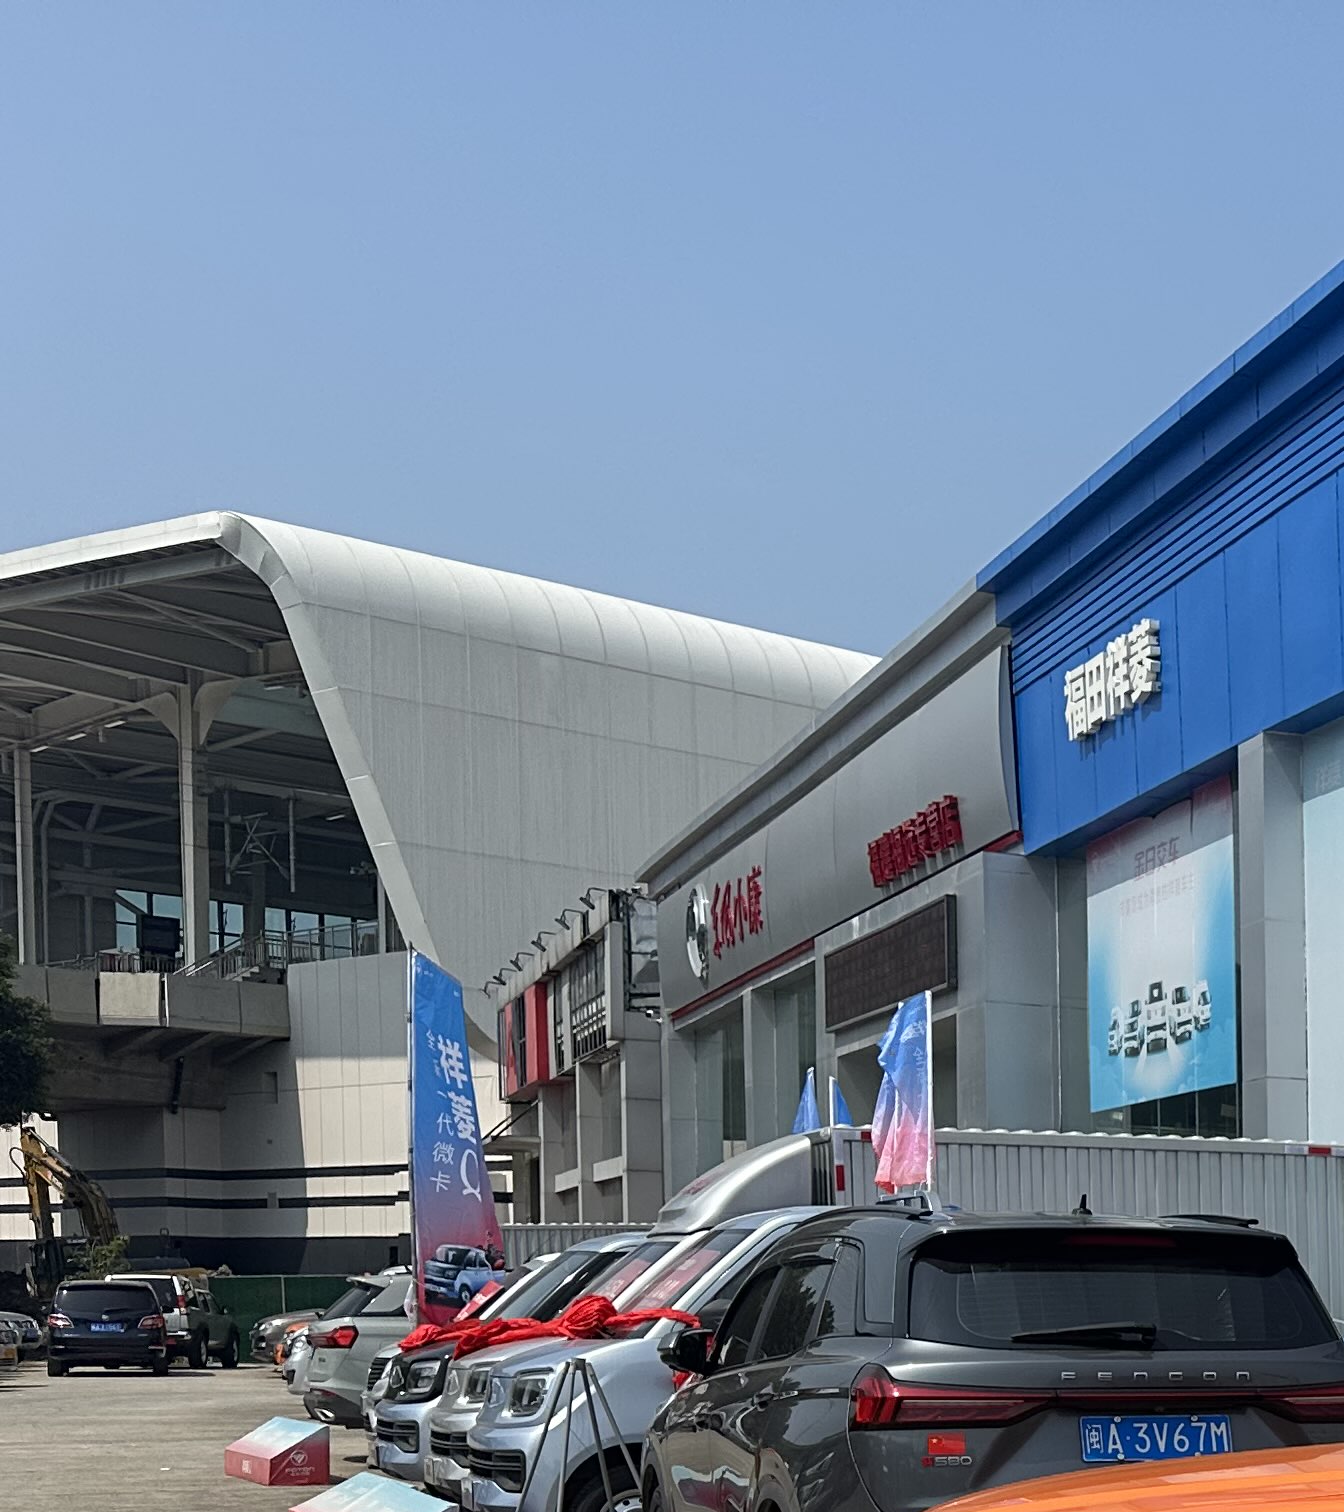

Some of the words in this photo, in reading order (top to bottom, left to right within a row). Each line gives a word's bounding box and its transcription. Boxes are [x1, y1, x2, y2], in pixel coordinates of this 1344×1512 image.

[1064, 618, 1160, 741] 福田祥菱
[1061, 1371, 1250, 1382] FENGON
